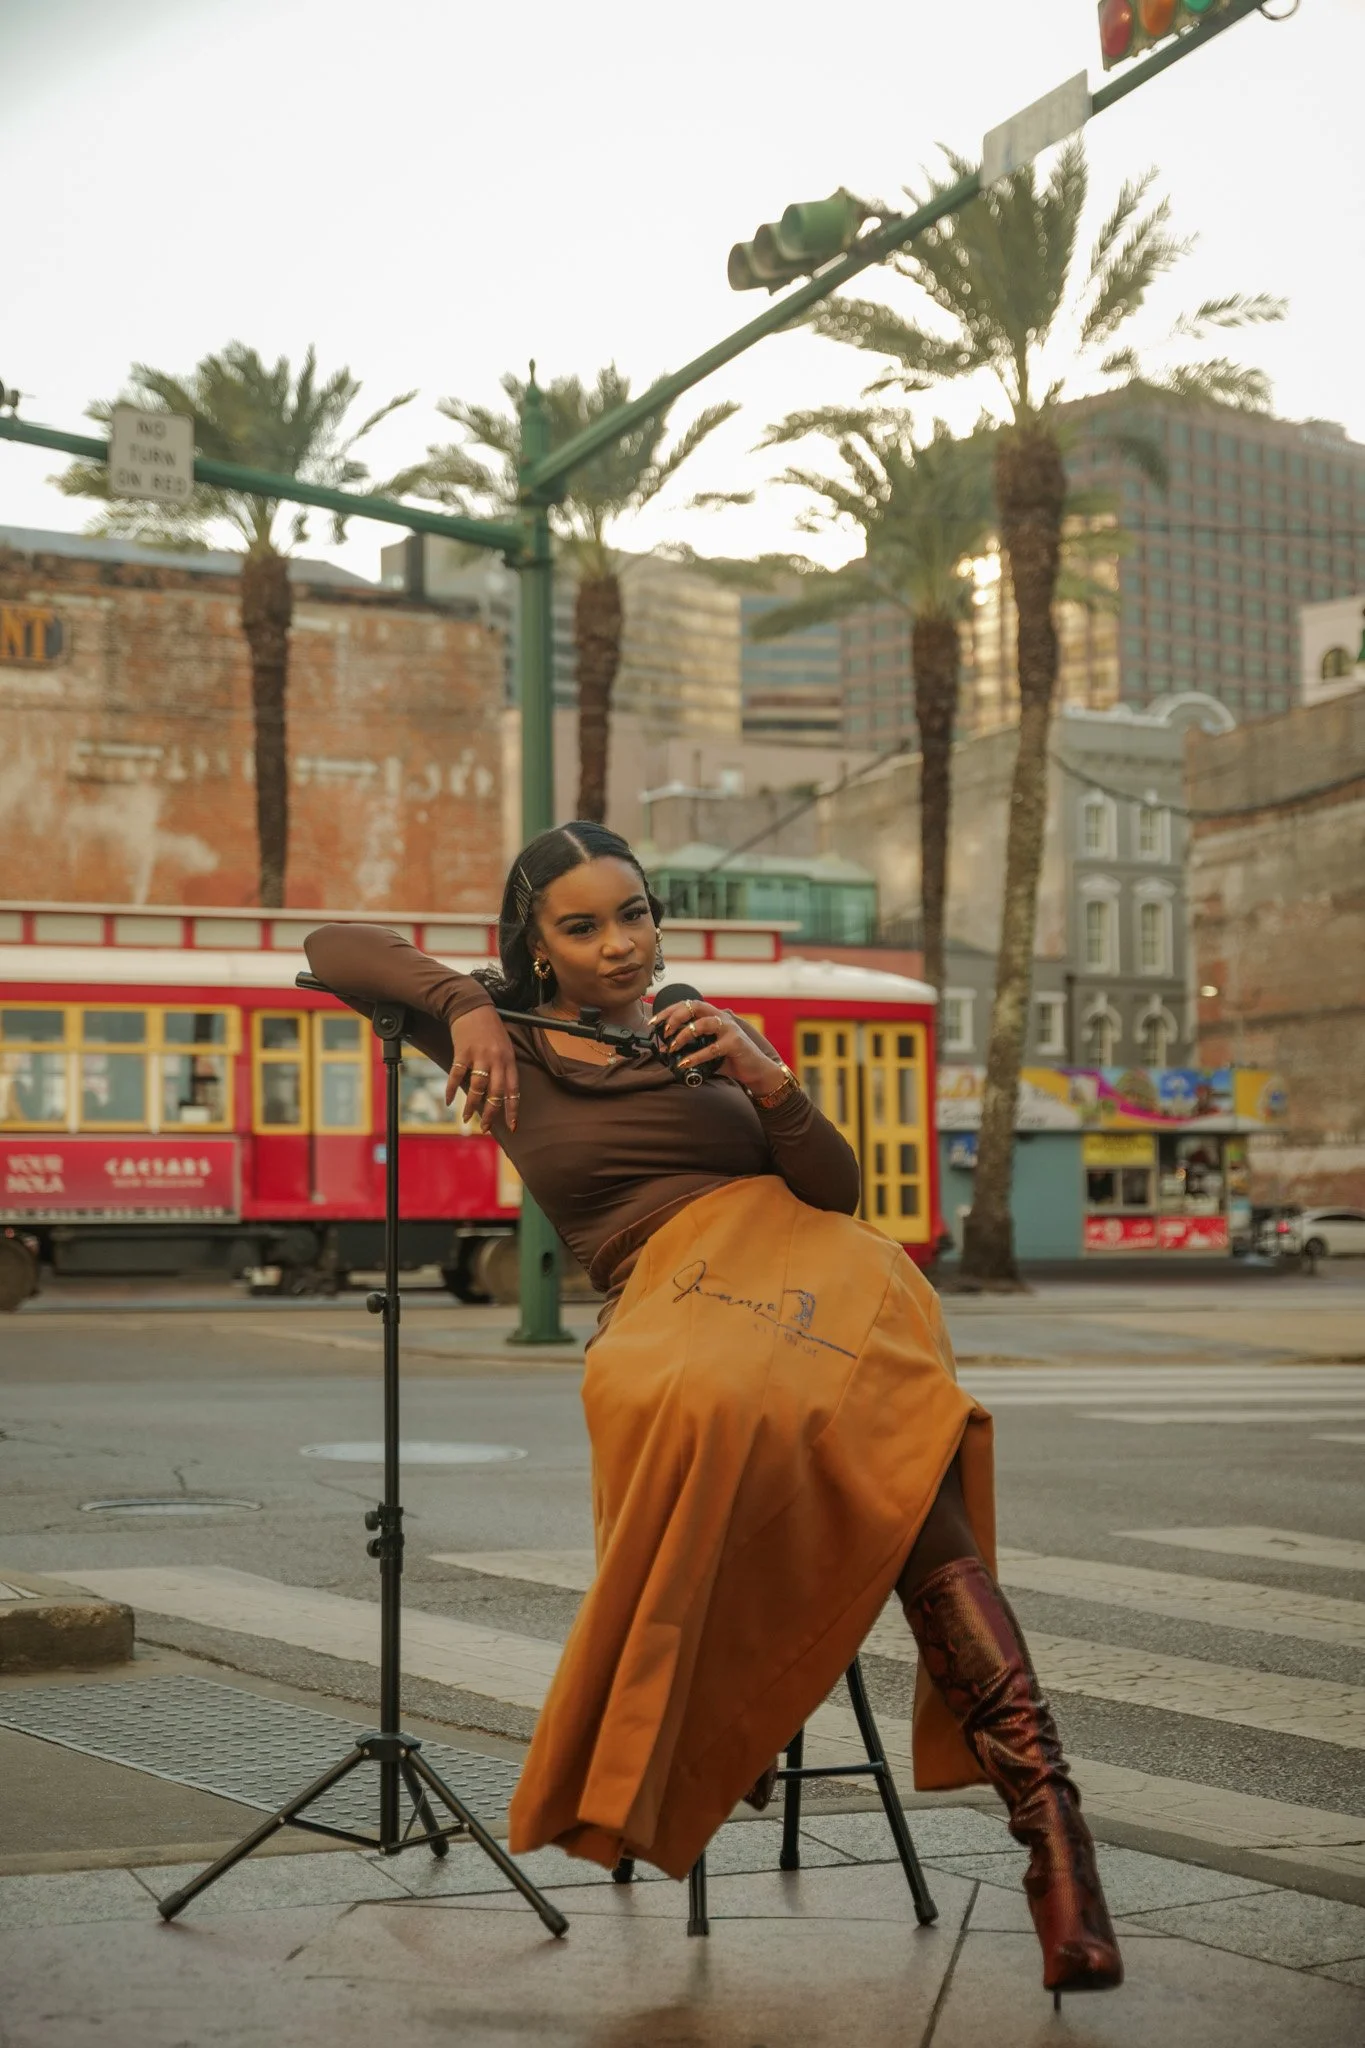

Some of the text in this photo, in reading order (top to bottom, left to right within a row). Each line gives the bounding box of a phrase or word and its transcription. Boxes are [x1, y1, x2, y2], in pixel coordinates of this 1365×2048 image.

[136, 419, 167, 441] NO
[129, 443, 177, 468] TURN
[117, 469, 188, 496] ON RED
[104, 1156, 212, 1176] CAESARS
